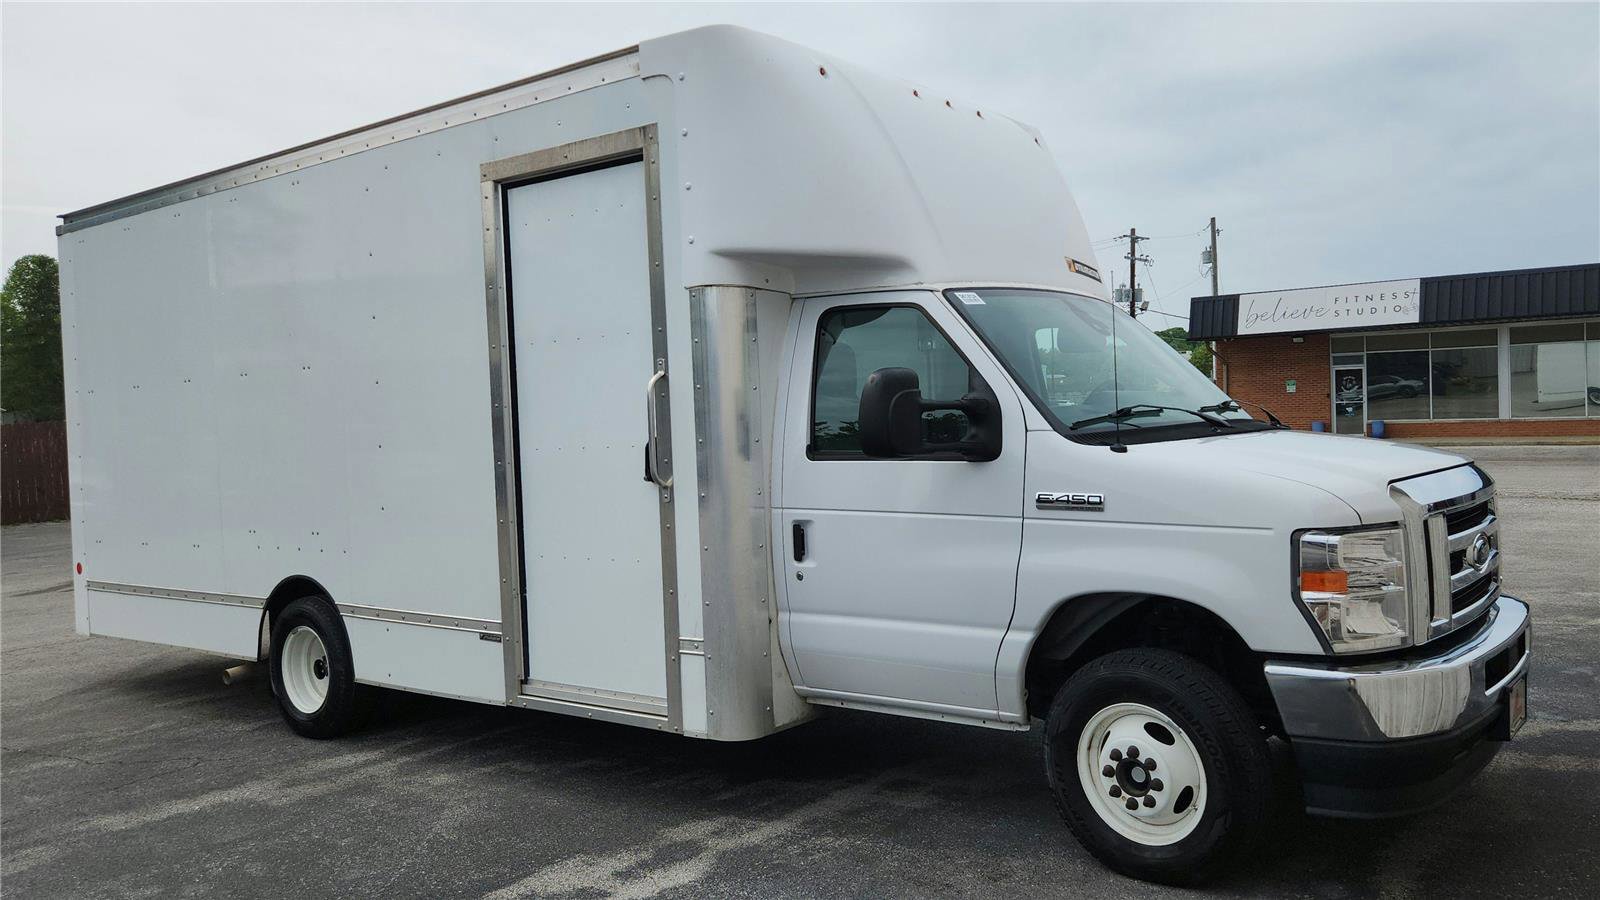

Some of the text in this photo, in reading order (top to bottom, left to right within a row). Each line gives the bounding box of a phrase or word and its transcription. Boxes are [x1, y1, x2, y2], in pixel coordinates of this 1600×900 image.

[1334, 291, 1410, 304] FITNESS
[1246, 297, 1332, 329] believe
[1334, 304, 1402, 317] STUDIO
